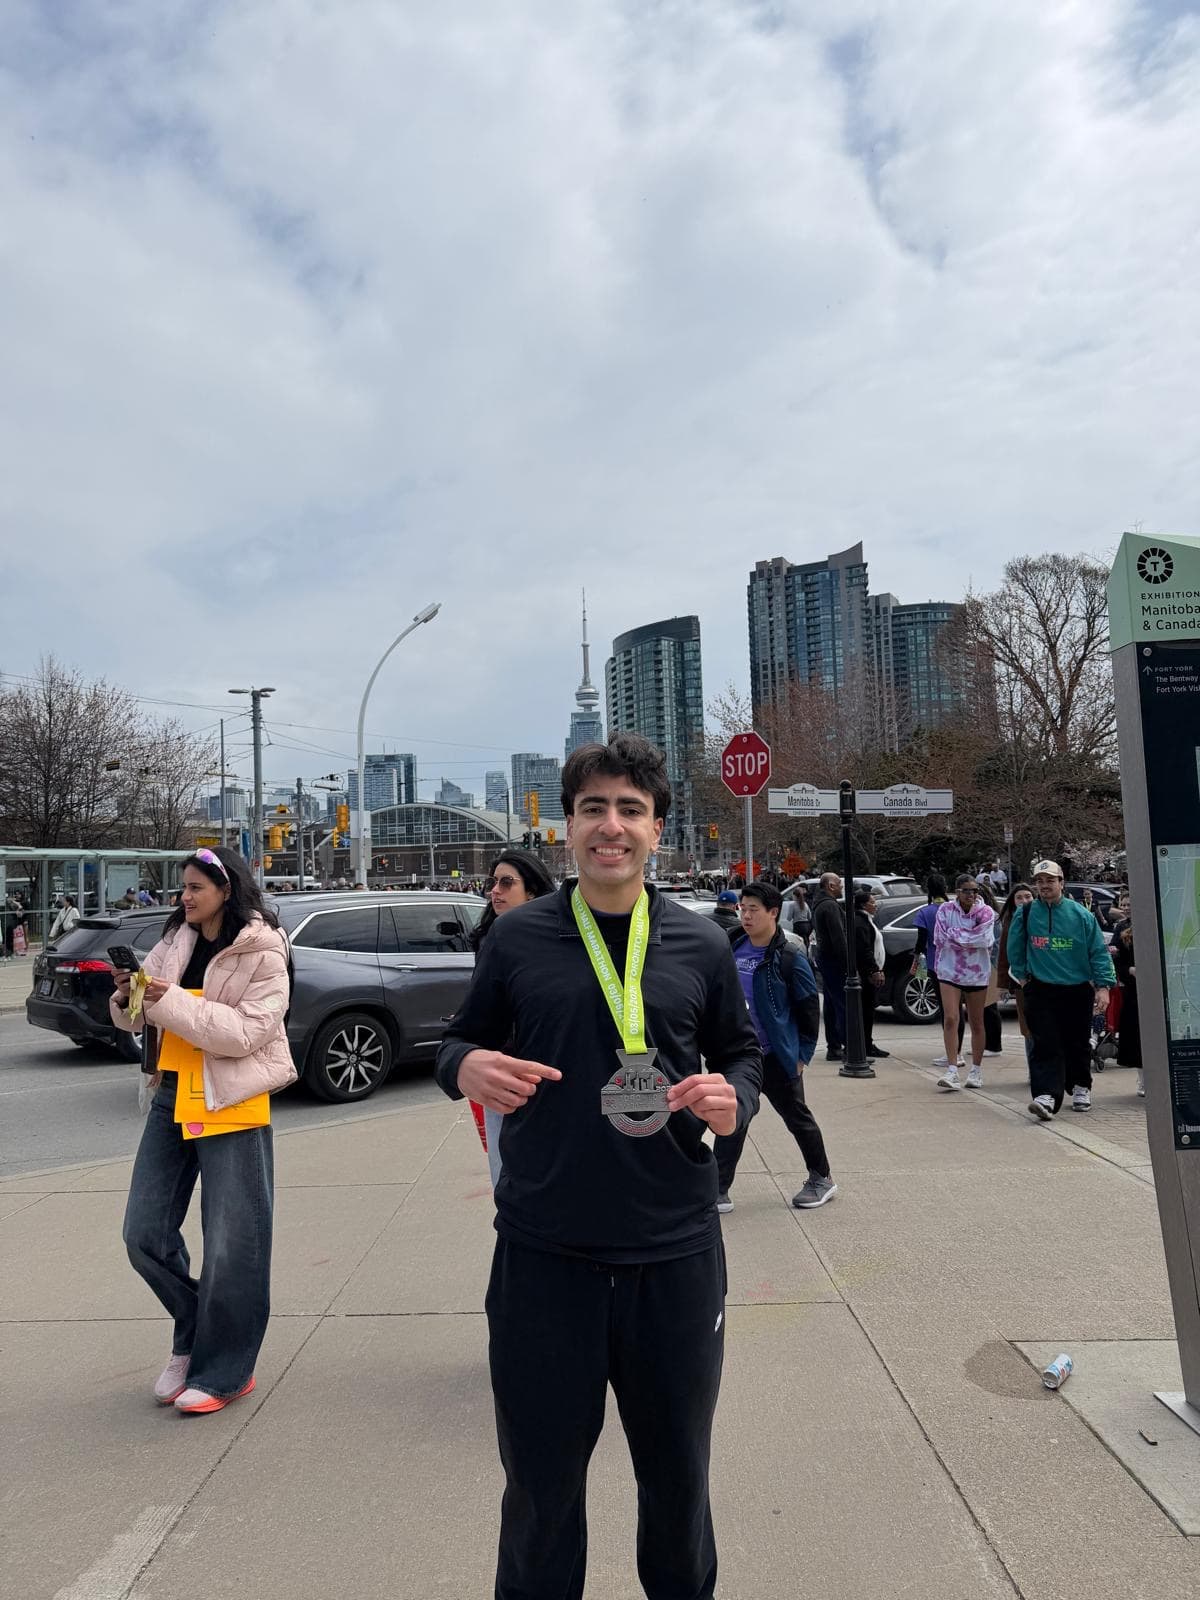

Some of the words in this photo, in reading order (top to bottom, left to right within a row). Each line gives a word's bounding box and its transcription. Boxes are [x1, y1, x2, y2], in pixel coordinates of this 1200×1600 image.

[1141, 591, 1200, 599] EXHIBITION
[1141, 603, 1200, 616] Manitoba
[1143, 620, 1151, 631] &
[725, 751, 767, 777] STOP
[787, 795, 814, 806] Manitoba
[883, 796, 912, 807] Canada
[914, 798, 928, 806] Blvd
[586, 930, 612, 981] MARATHON
[630, 936, 643, 982] TORONTO
